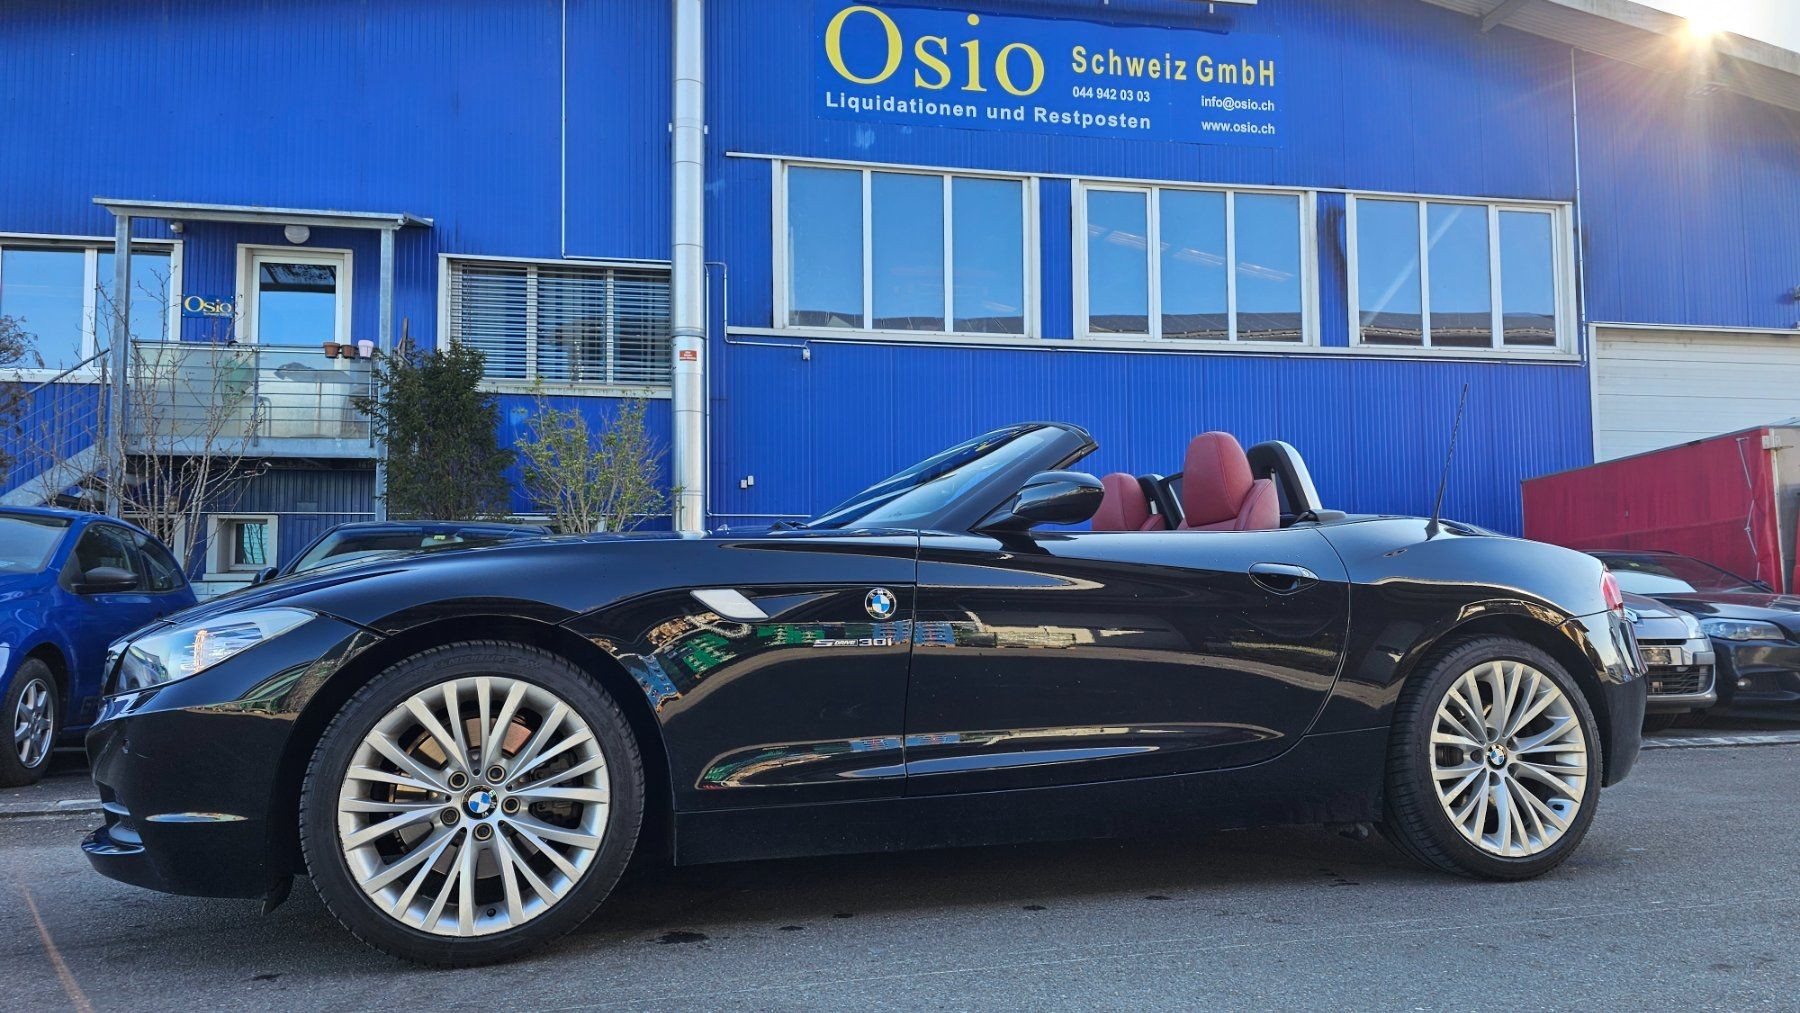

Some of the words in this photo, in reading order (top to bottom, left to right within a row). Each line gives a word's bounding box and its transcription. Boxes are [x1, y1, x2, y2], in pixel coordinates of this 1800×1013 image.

[825, 5, 1045, 96] Osio
[1072, 45, 1187, 80] Schweiz
[1196, 55, 1275, 87] GmbH
[1072, 86, 1094, 99] 044
[1096, 88, 1117, 101] 942
[1120, 89, 1134, 101] 03
[1137, 91, 1150, 103] 03
[1201, 95, 1275, 111] info@osio.ch
[826, 91, 977, 117] Liquidationen
[986, 106, 1025, 121] und
[1034, 107, 1150, 130] Restposten
[1201, 120, 1275, 134] www.osio.ch
[184, 296, 232, 312] Osio
